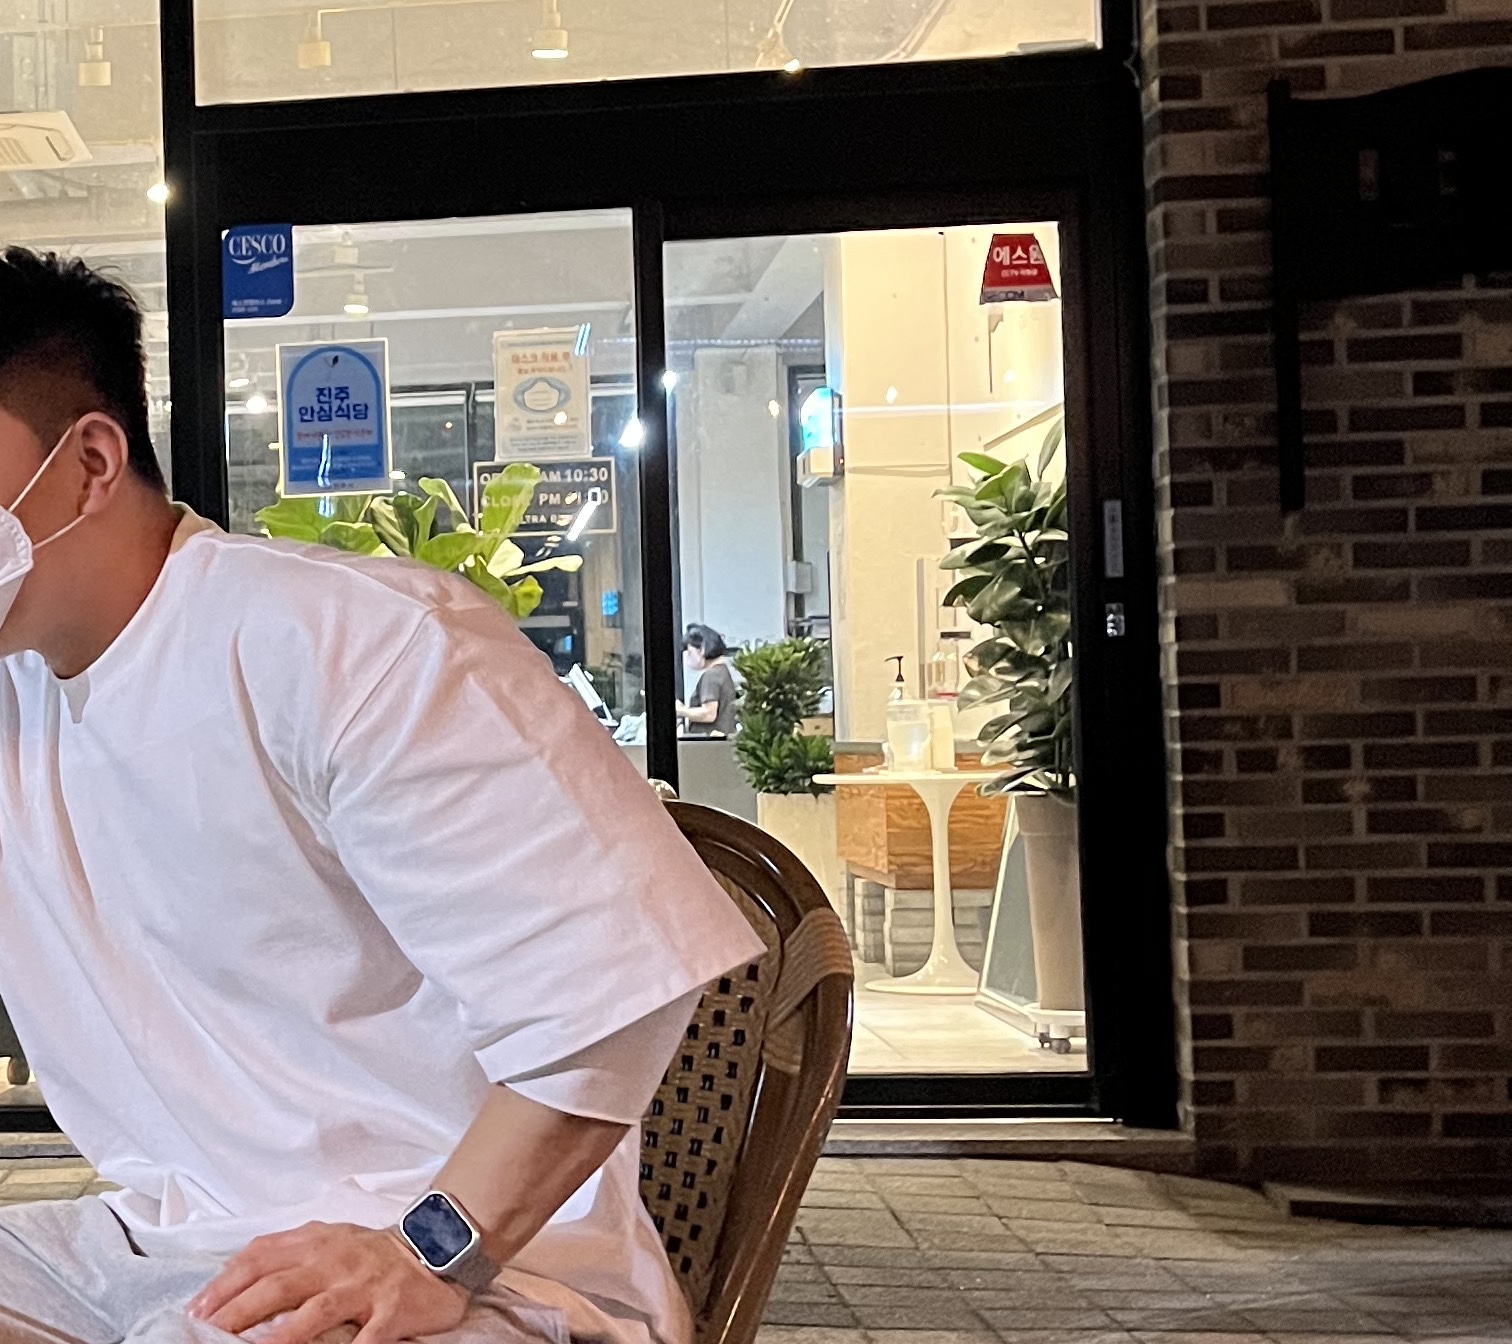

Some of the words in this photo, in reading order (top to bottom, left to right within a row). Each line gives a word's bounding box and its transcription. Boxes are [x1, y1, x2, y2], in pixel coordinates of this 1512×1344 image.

[228, 233, 286, 256] CESCO
[316, 386, 350, 405] 진주
[298, 403, 369, 423] 안심식당
[540, 470, 562, 483] AM
[565, 467, 608, 483] 10:30
[538, 493, 561, 506] PM
